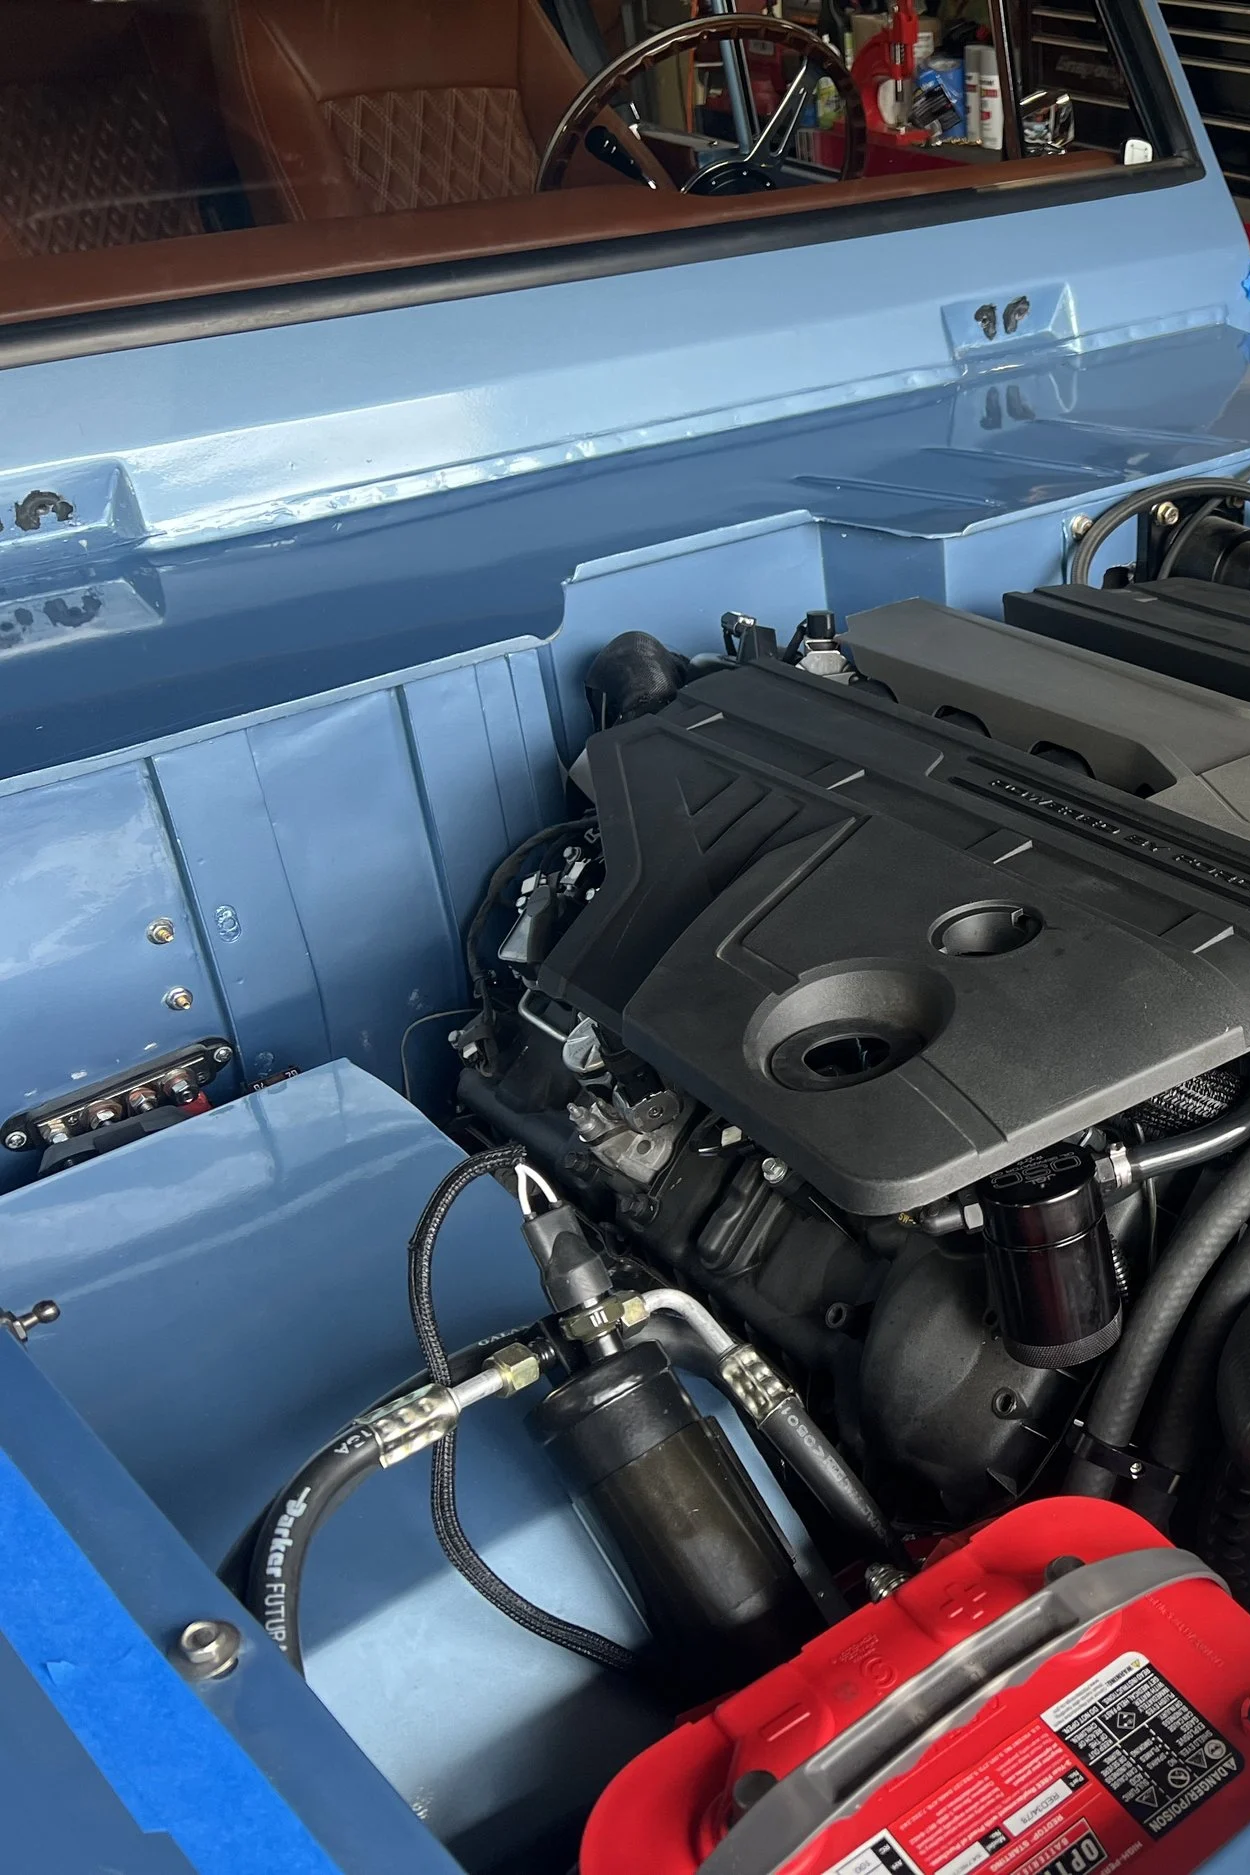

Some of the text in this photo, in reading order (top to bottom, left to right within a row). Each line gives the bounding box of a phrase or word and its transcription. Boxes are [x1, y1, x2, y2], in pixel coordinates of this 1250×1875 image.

[265, 1487, 311, 1577] Parker
[264, 1583, 287, 1651] FUTUR
[1068, 1774, 1084, 1788] Part
[1148, 1764, 1227, 1833] DANGER/POISON
[989, 1838, 1030, 1872] STARTING
